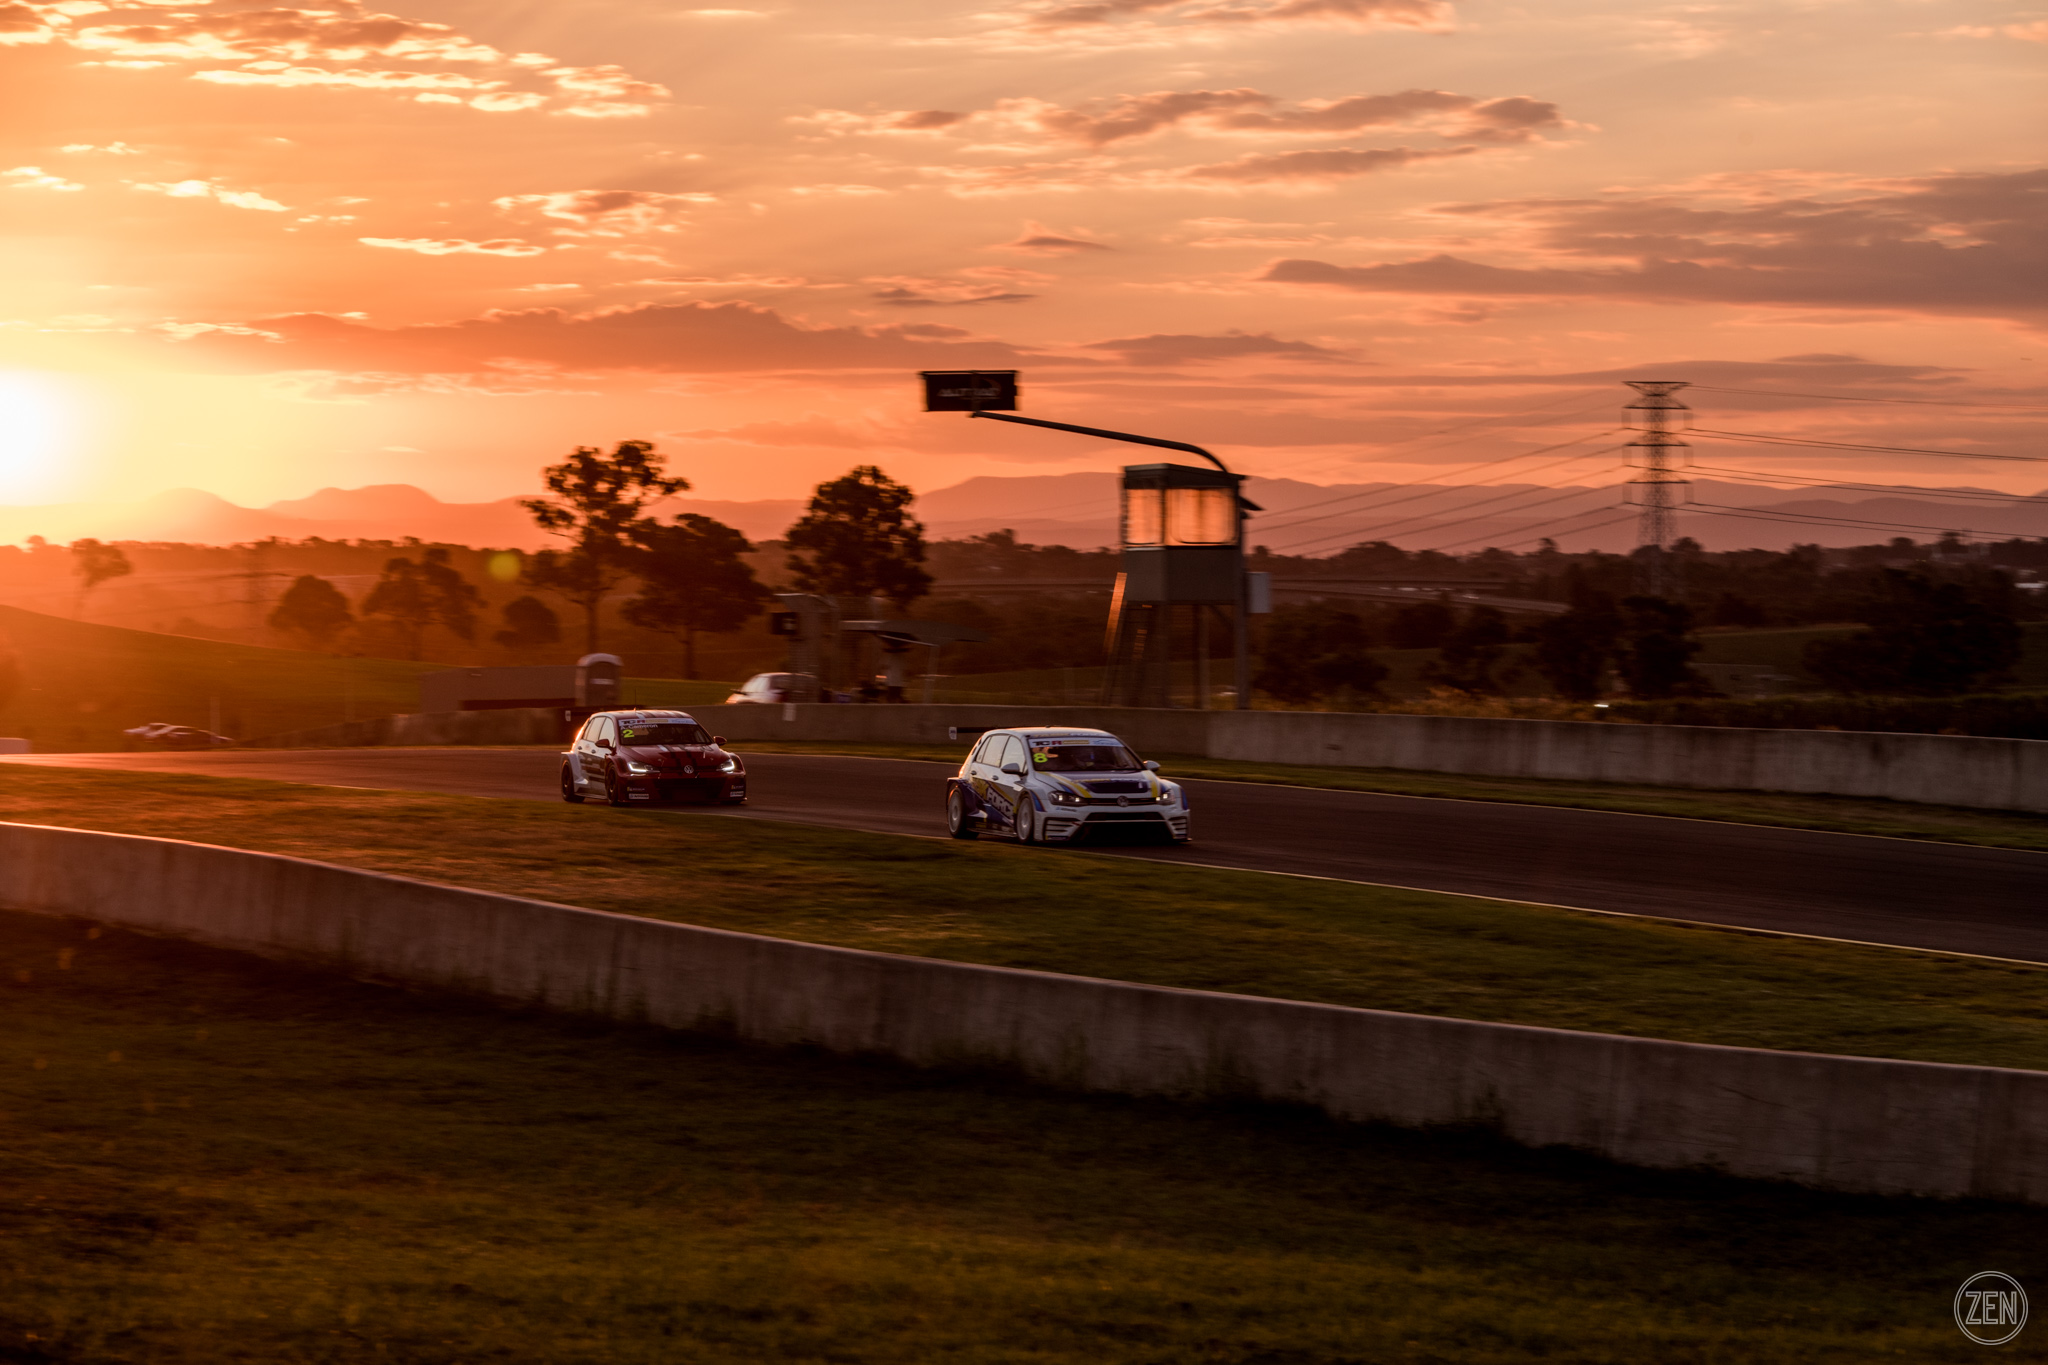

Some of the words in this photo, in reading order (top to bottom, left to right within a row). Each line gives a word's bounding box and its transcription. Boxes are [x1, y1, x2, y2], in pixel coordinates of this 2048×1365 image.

[623, 729, 635, 738] 2
[1033, 752, 1048, 763] 8
[987, 787, 1015, 821] FORC
